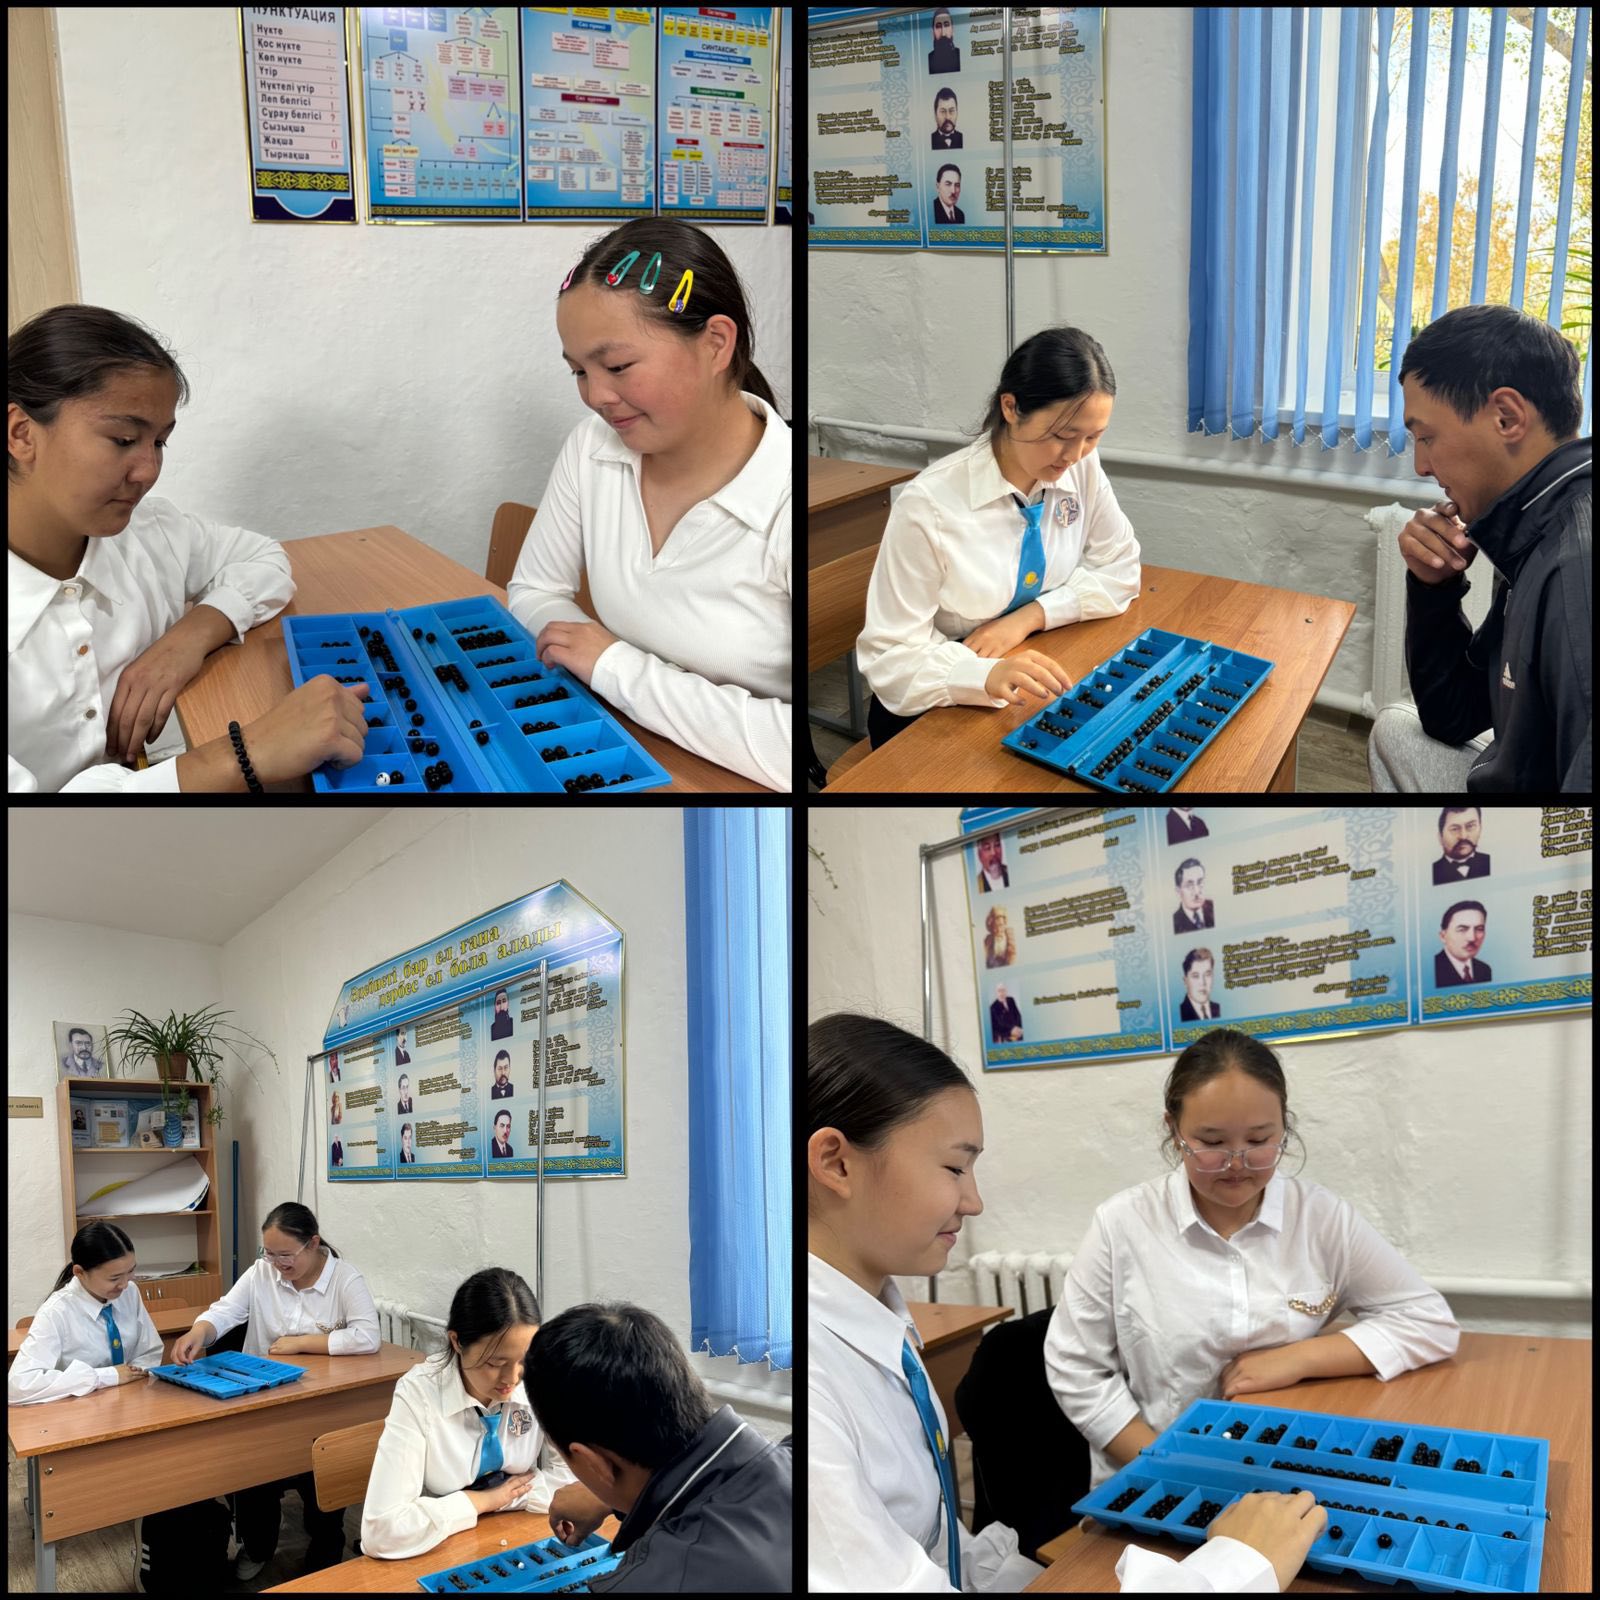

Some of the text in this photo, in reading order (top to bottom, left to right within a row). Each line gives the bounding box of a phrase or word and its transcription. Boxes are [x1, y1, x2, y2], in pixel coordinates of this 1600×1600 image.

[253, 7, 336, 23] ПУНКТУАЦИЯ
[257, 24, 283, 36] Нүкте
[258, 38, 301, 52] Қос нүкте
[258, 52, 302, 66] Көп нүкте
[259, 66, 278, 77] Үтір
[260, 80, 315, 94] Нүктелі үтір
[261, 94, 278, 104] Леп
[279, 94, 311, 106] белгісі
[261, 107, 289, 121] Сұрау
[291, 109, 322, 121] белгісі
[262, 121, 306, 134] Сызықша
[263, 135, 294, 147] Жақша
[264, 149, 310, 161] Тырнақша
[1563, 819, 1592, 833] көзің
[1541, 842, 1592, 857] Ұйықтай
[1554, 911, 1592, 924] тілект
[1551, 921, 1592, 935] жүрект
[404, 955, 428, 979] бар
[436, 945, 453, 966] ел
[459, 925, 500, 956] ғана
[378, 921, 562, 1009] дербес ел бола алады
